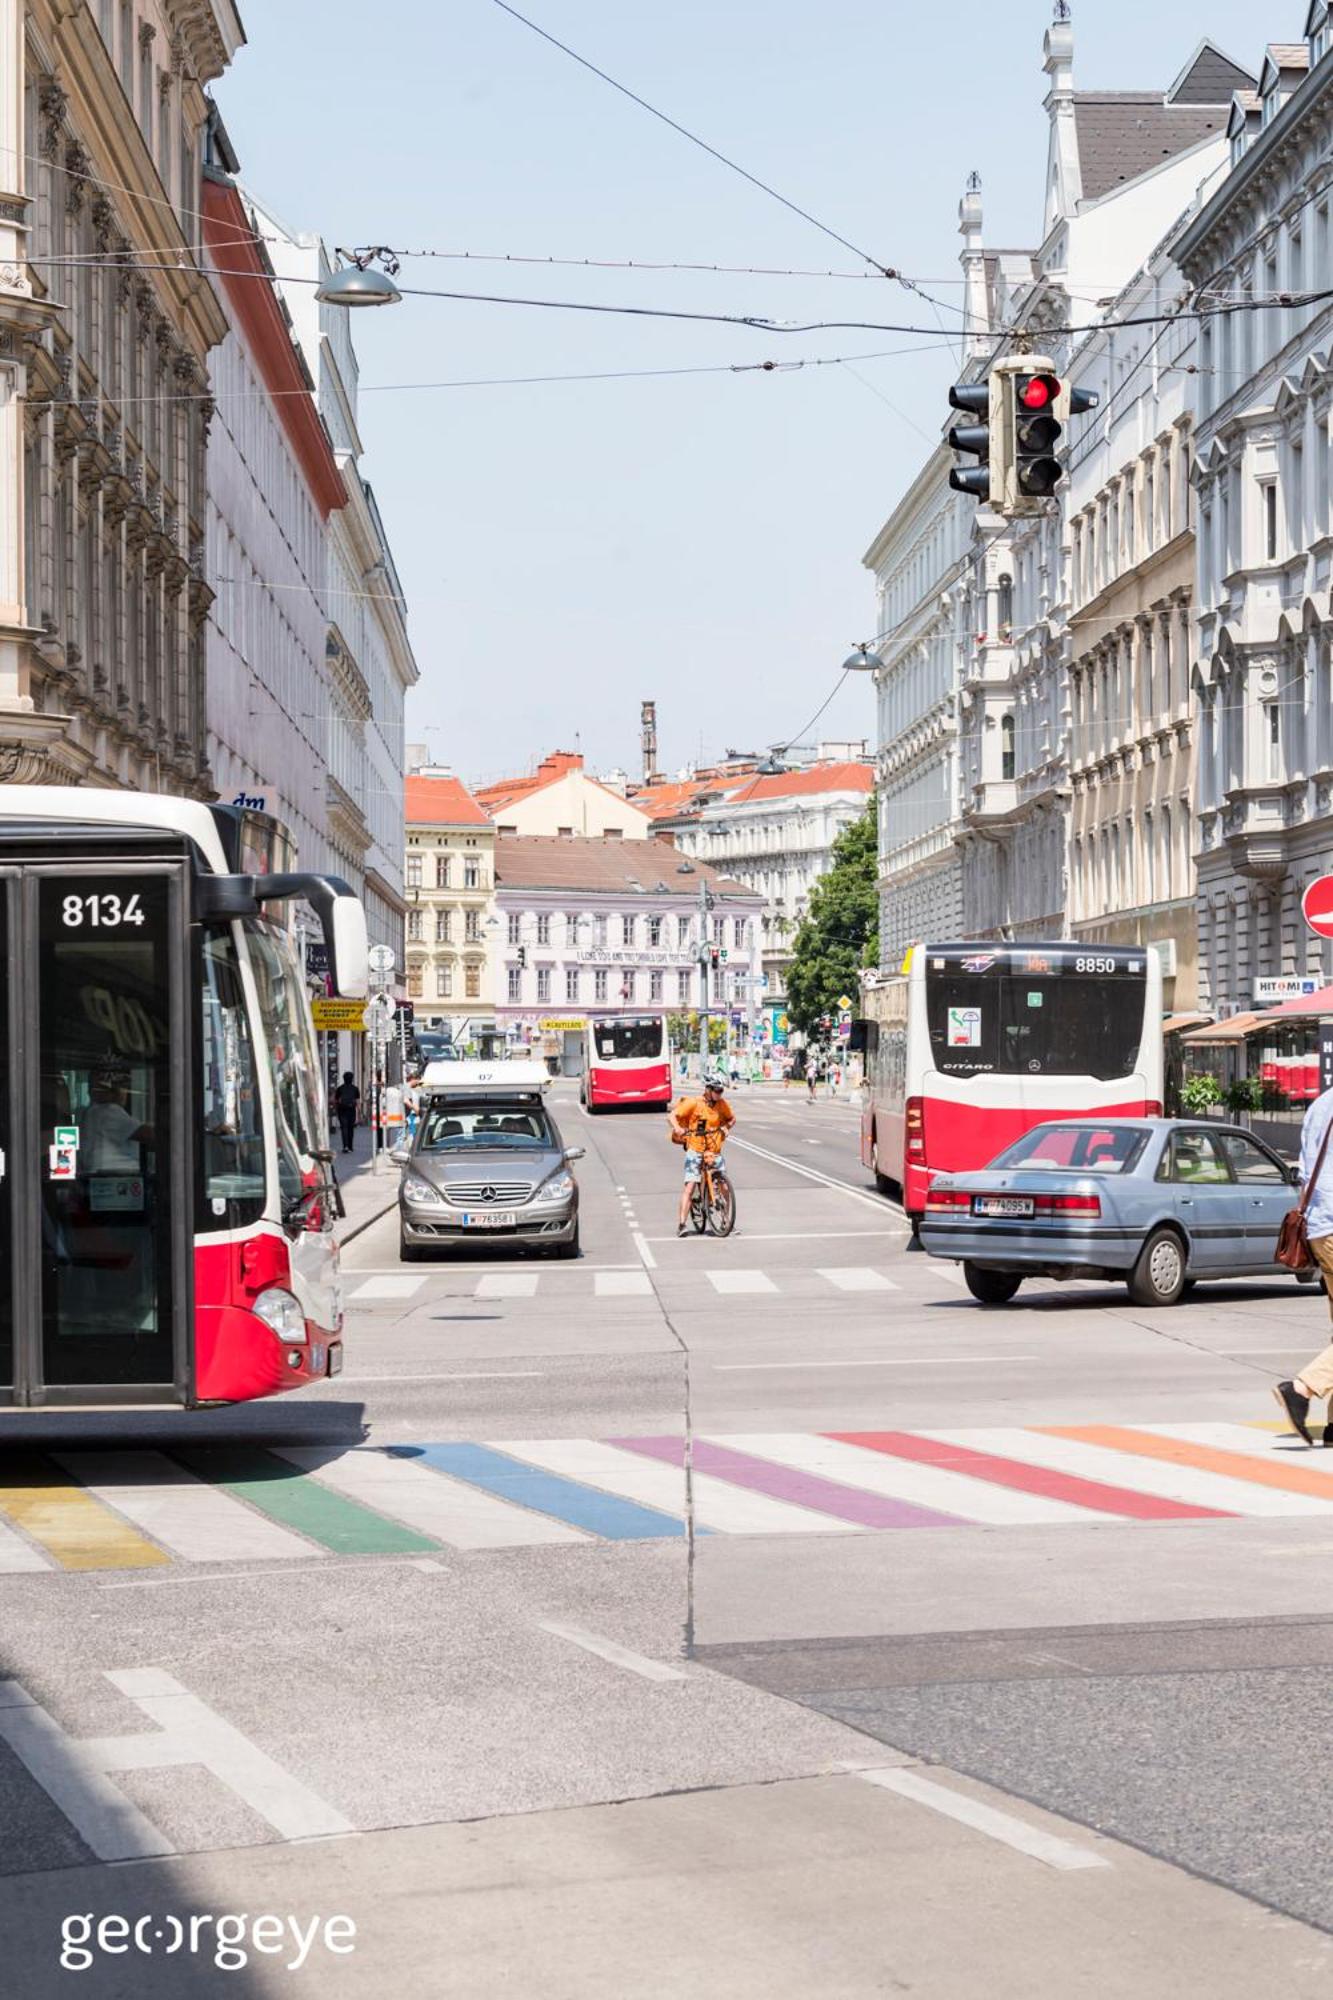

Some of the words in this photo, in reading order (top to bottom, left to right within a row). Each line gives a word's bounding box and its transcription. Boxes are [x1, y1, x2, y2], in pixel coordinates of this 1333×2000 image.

[232, 792, 265, 811] dm
[62, 894, 145, 927] 8134
[1075, 957, 1116, 973] 8850
